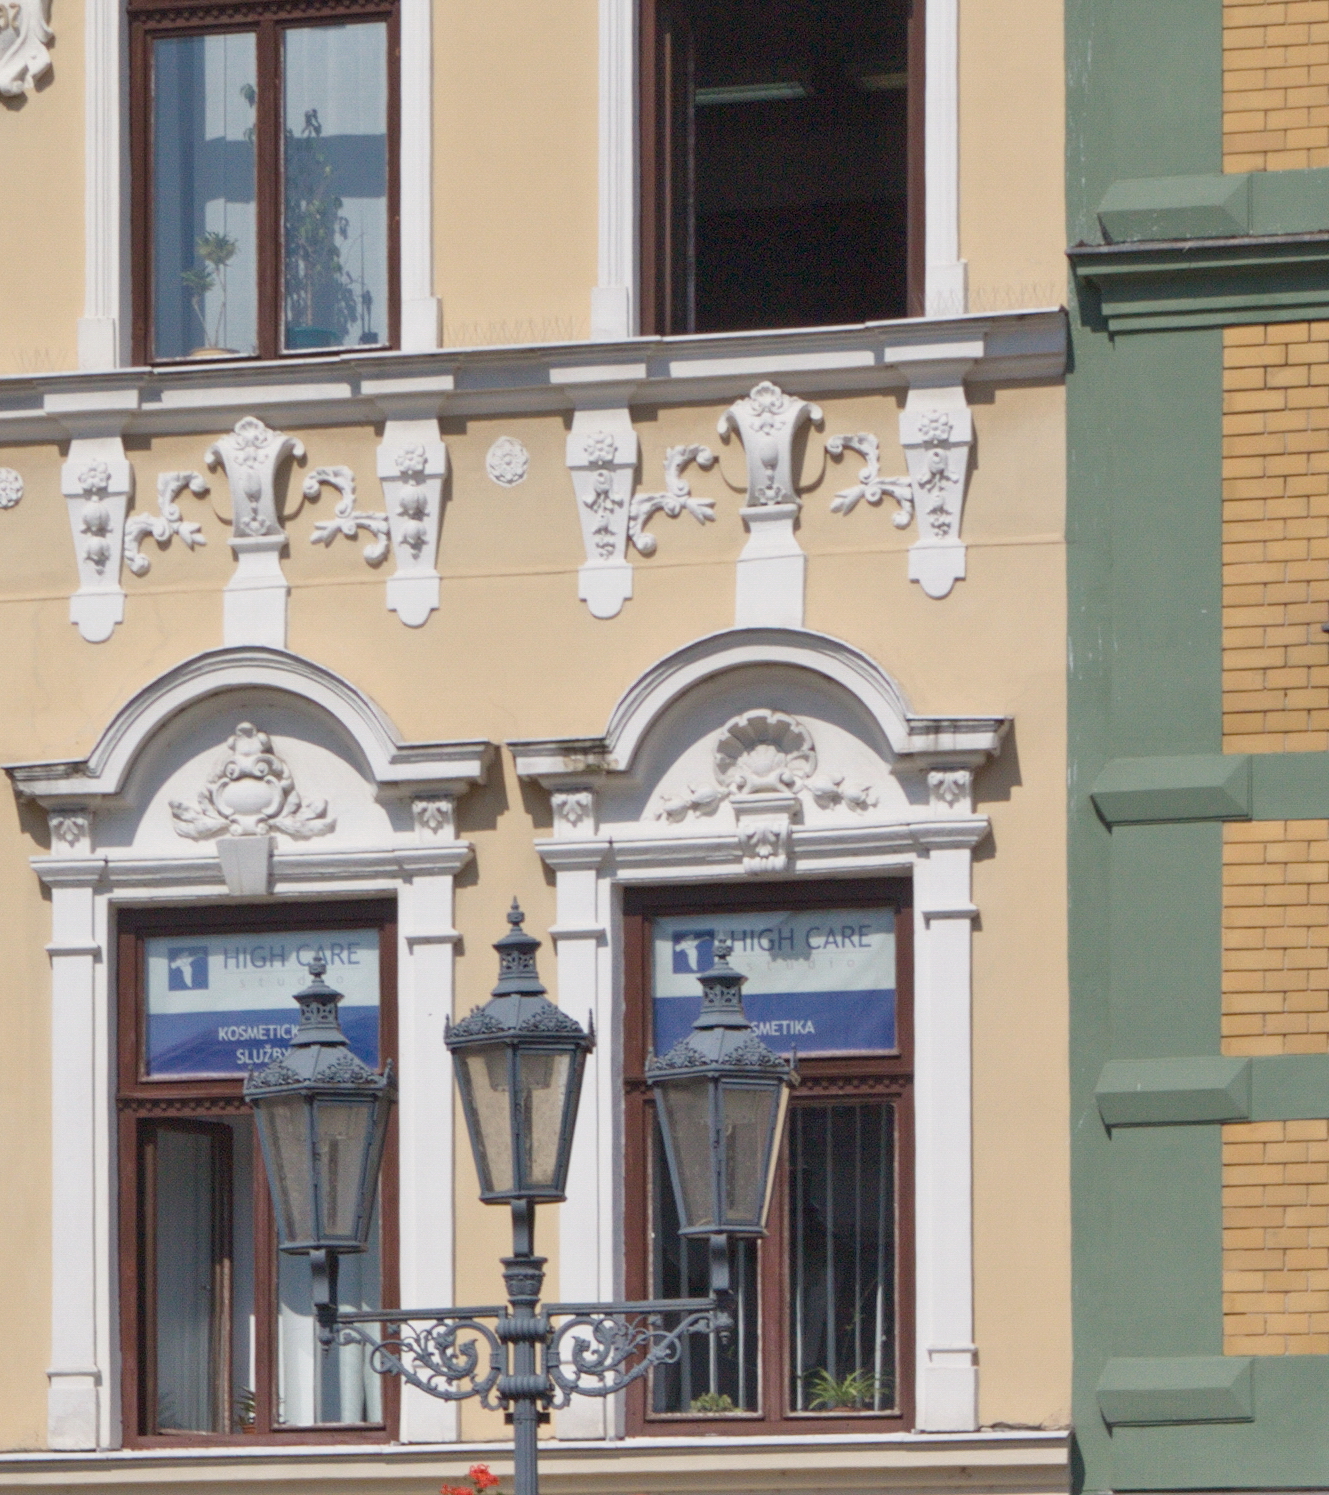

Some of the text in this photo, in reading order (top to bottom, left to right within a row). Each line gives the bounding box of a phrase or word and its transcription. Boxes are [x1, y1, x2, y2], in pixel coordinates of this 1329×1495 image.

[731, 925, 872, 952] HIGH CARE
[223, 942, 361, 969] HIGH CARE
[239, 975, 344, 988] studo
[218, 1023, 300, 1041] KOSMETICK
[751, 1020, 815, 1037] SMETIKA
